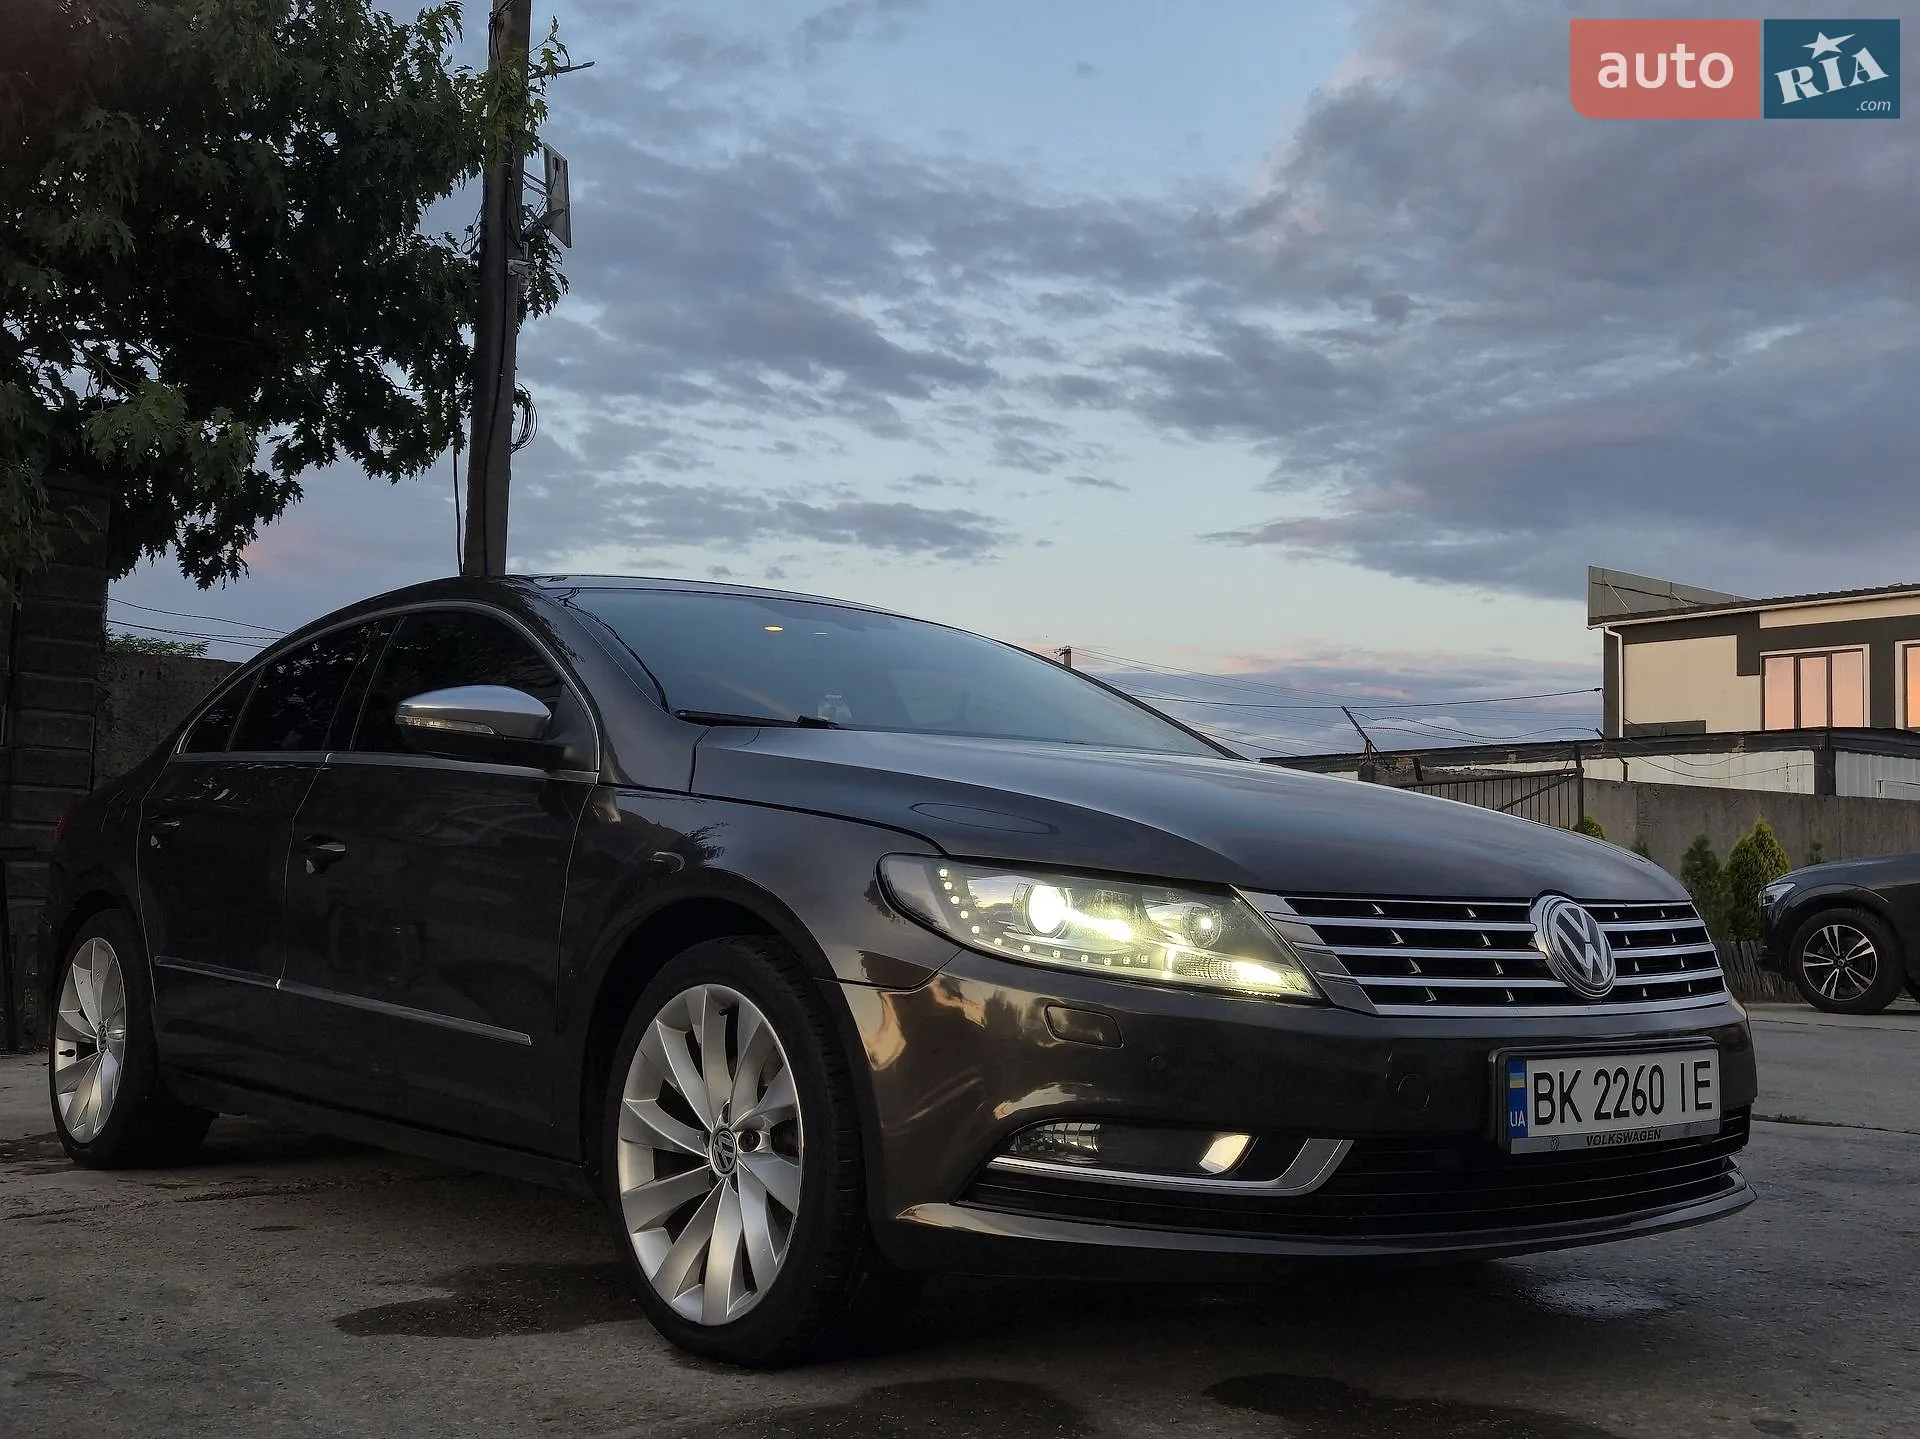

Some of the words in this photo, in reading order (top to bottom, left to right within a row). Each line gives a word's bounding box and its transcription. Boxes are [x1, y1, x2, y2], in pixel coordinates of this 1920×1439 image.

[1533, 1069, 1583, 1126] BK
[1593, 1064, 1665, 1121] 2260
[1680, 1060, 1713, 1113] IE
[1509, 1110, 1526, 1127] UA
[1586, 1129, 1662, 1147] VOLKSWAGEN
